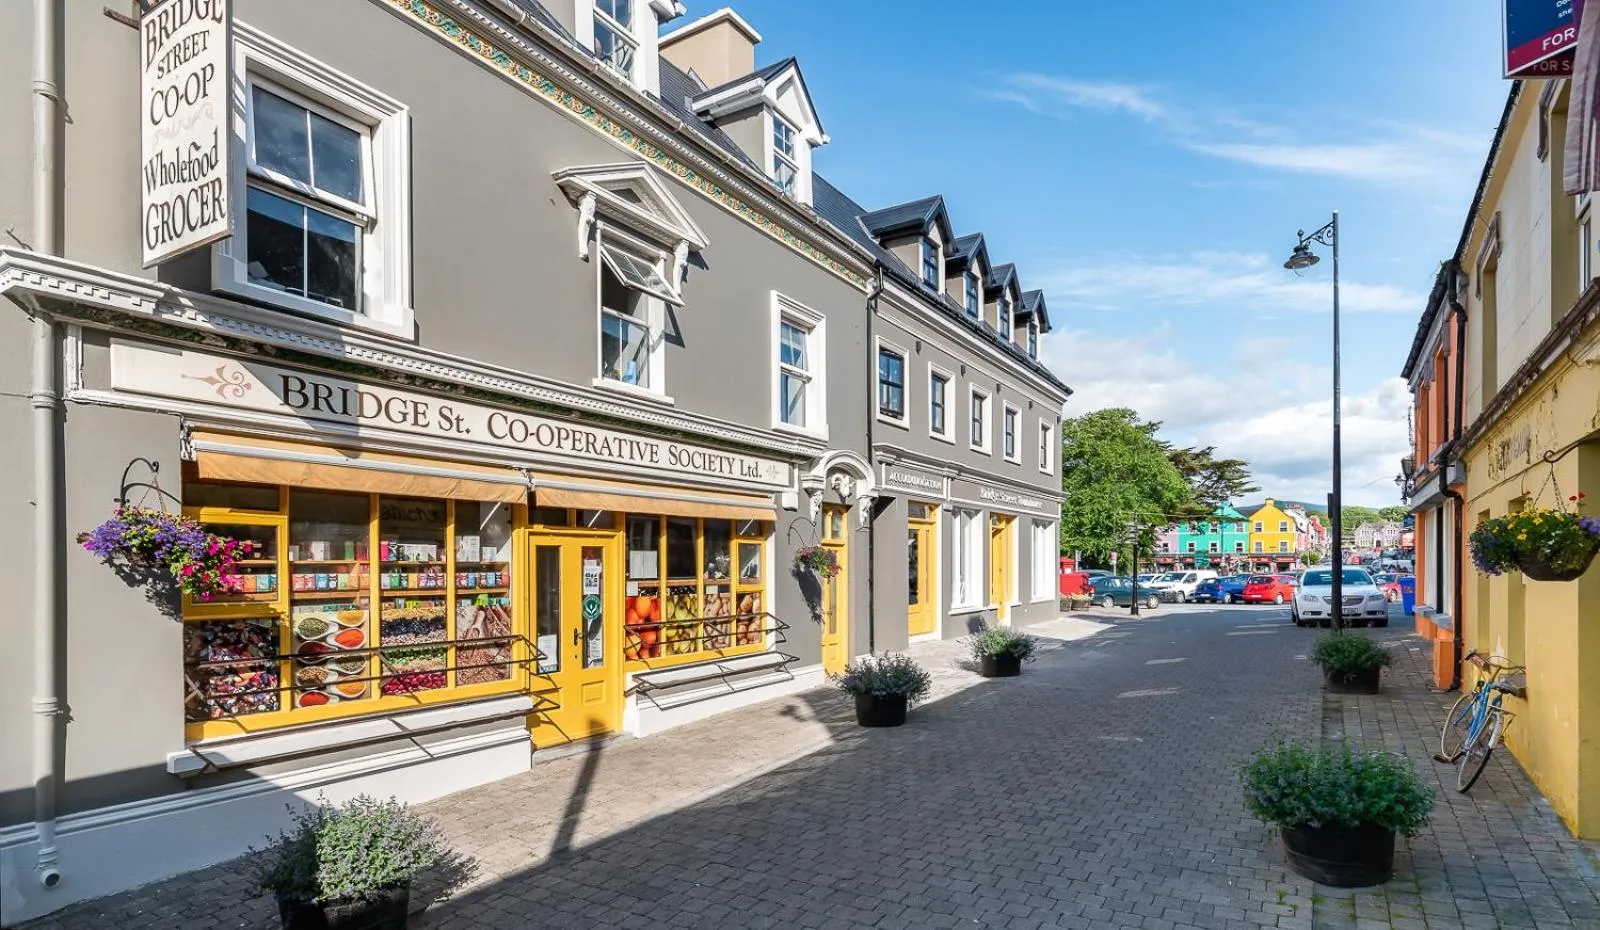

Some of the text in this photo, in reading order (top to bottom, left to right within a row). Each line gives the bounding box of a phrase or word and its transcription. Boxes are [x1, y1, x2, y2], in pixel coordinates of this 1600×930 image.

[145, 0, 223, 73] BRIDGE
[157, 30, 209, 79] STREET
[1533, 60, 1558, 71] FOR
[1542, 28, 1575, 50] FOR
[151, 62, 215, 126] CO-OP
[144, 126, 218, 196] Wholefood
[145, 177, 226, 250] GROCER
[278, 374, 763, 478] BRIDGE St. CO-OPERATIVE SOCIETY Ltd.
